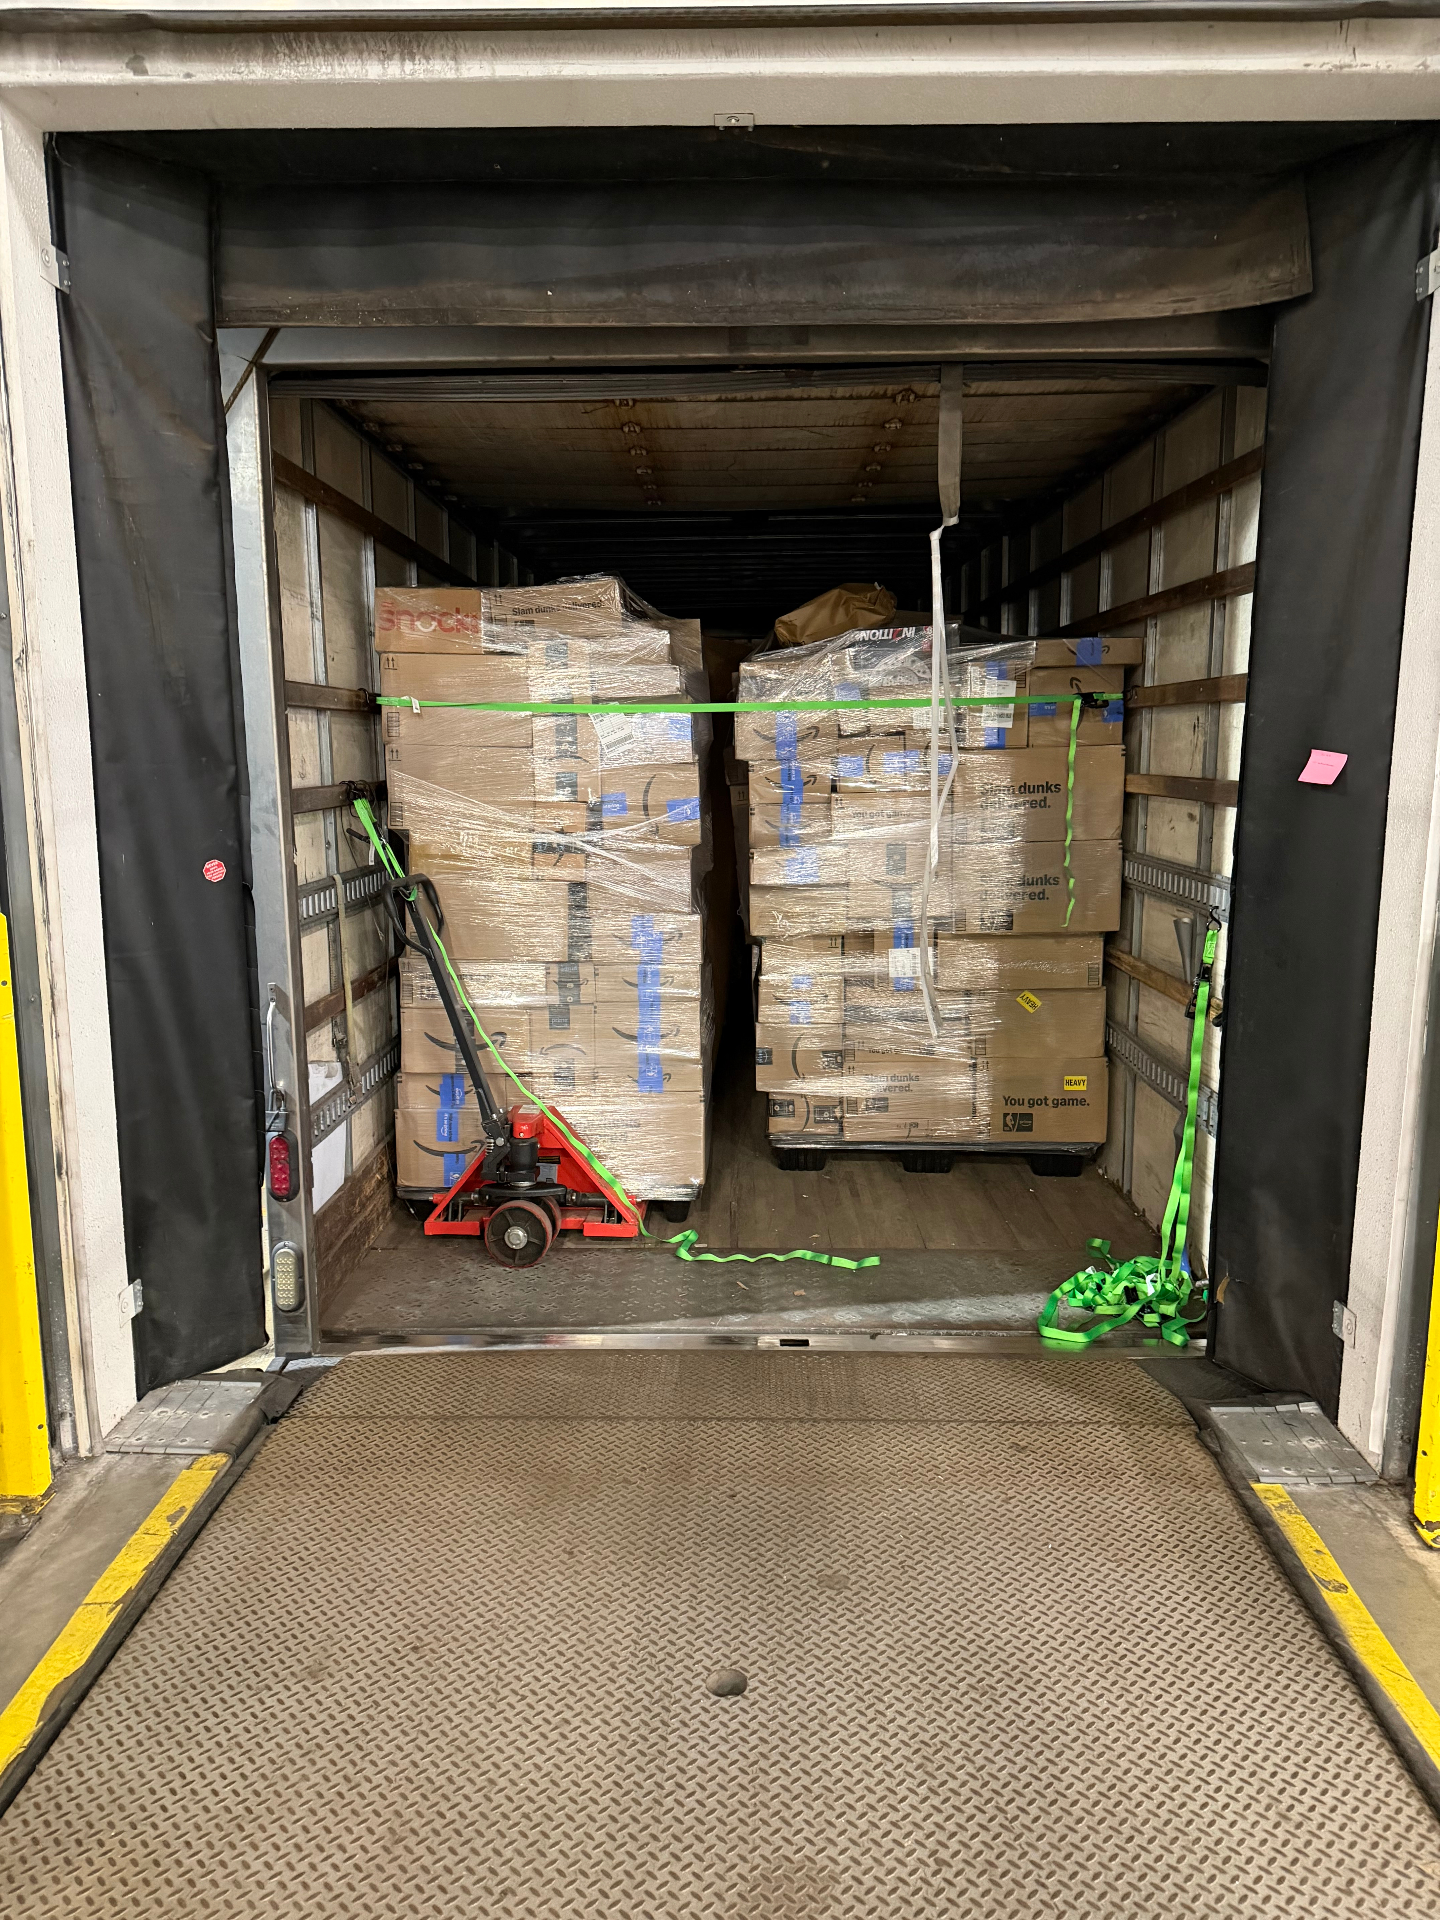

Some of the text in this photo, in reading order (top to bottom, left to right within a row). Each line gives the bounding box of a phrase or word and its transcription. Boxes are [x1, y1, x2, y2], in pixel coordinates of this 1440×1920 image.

[512, 606, 534, 616] Slam
[1018, 781, 1062, 795] dunks
[1018, 874, 1061, 887] dunks
[980, 888, 1050, 901] vered.
[1020, 994, 1039, 1010] HEAVY
[890, 1073, 920, 1083] dunks
[1065, 1079, 1087, 1087] HEAVY
[866, 1084, 913, 1093] ivered.
[1003, 1095, 1090, 1109] You got game.
